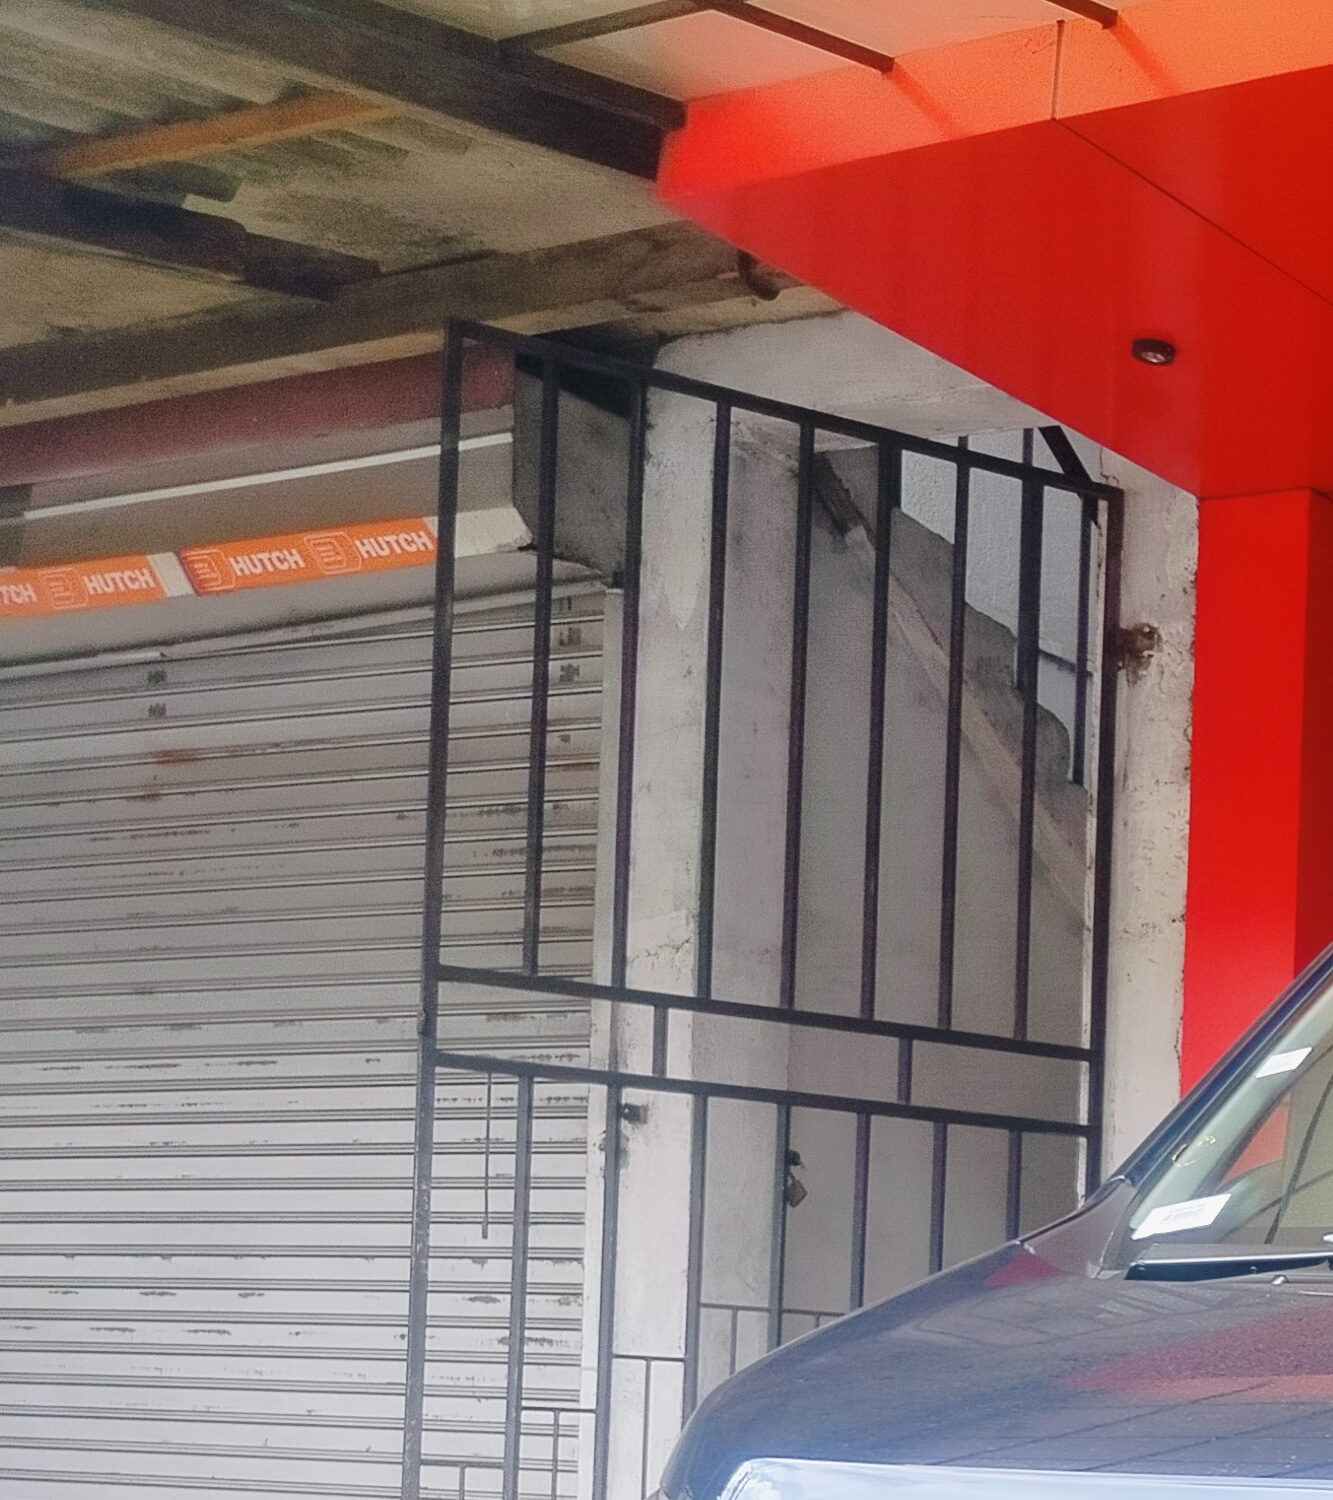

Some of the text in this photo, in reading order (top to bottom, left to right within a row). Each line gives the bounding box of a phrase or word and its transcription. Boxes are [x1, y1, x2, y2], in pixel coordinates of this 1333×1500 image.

[354, 531, 434, 558] HUTCH
[229, 548, 305, 577] HUTCH
[0, 583, 38, 605] TCH
[83, 568, 156, 596] HUTCH
